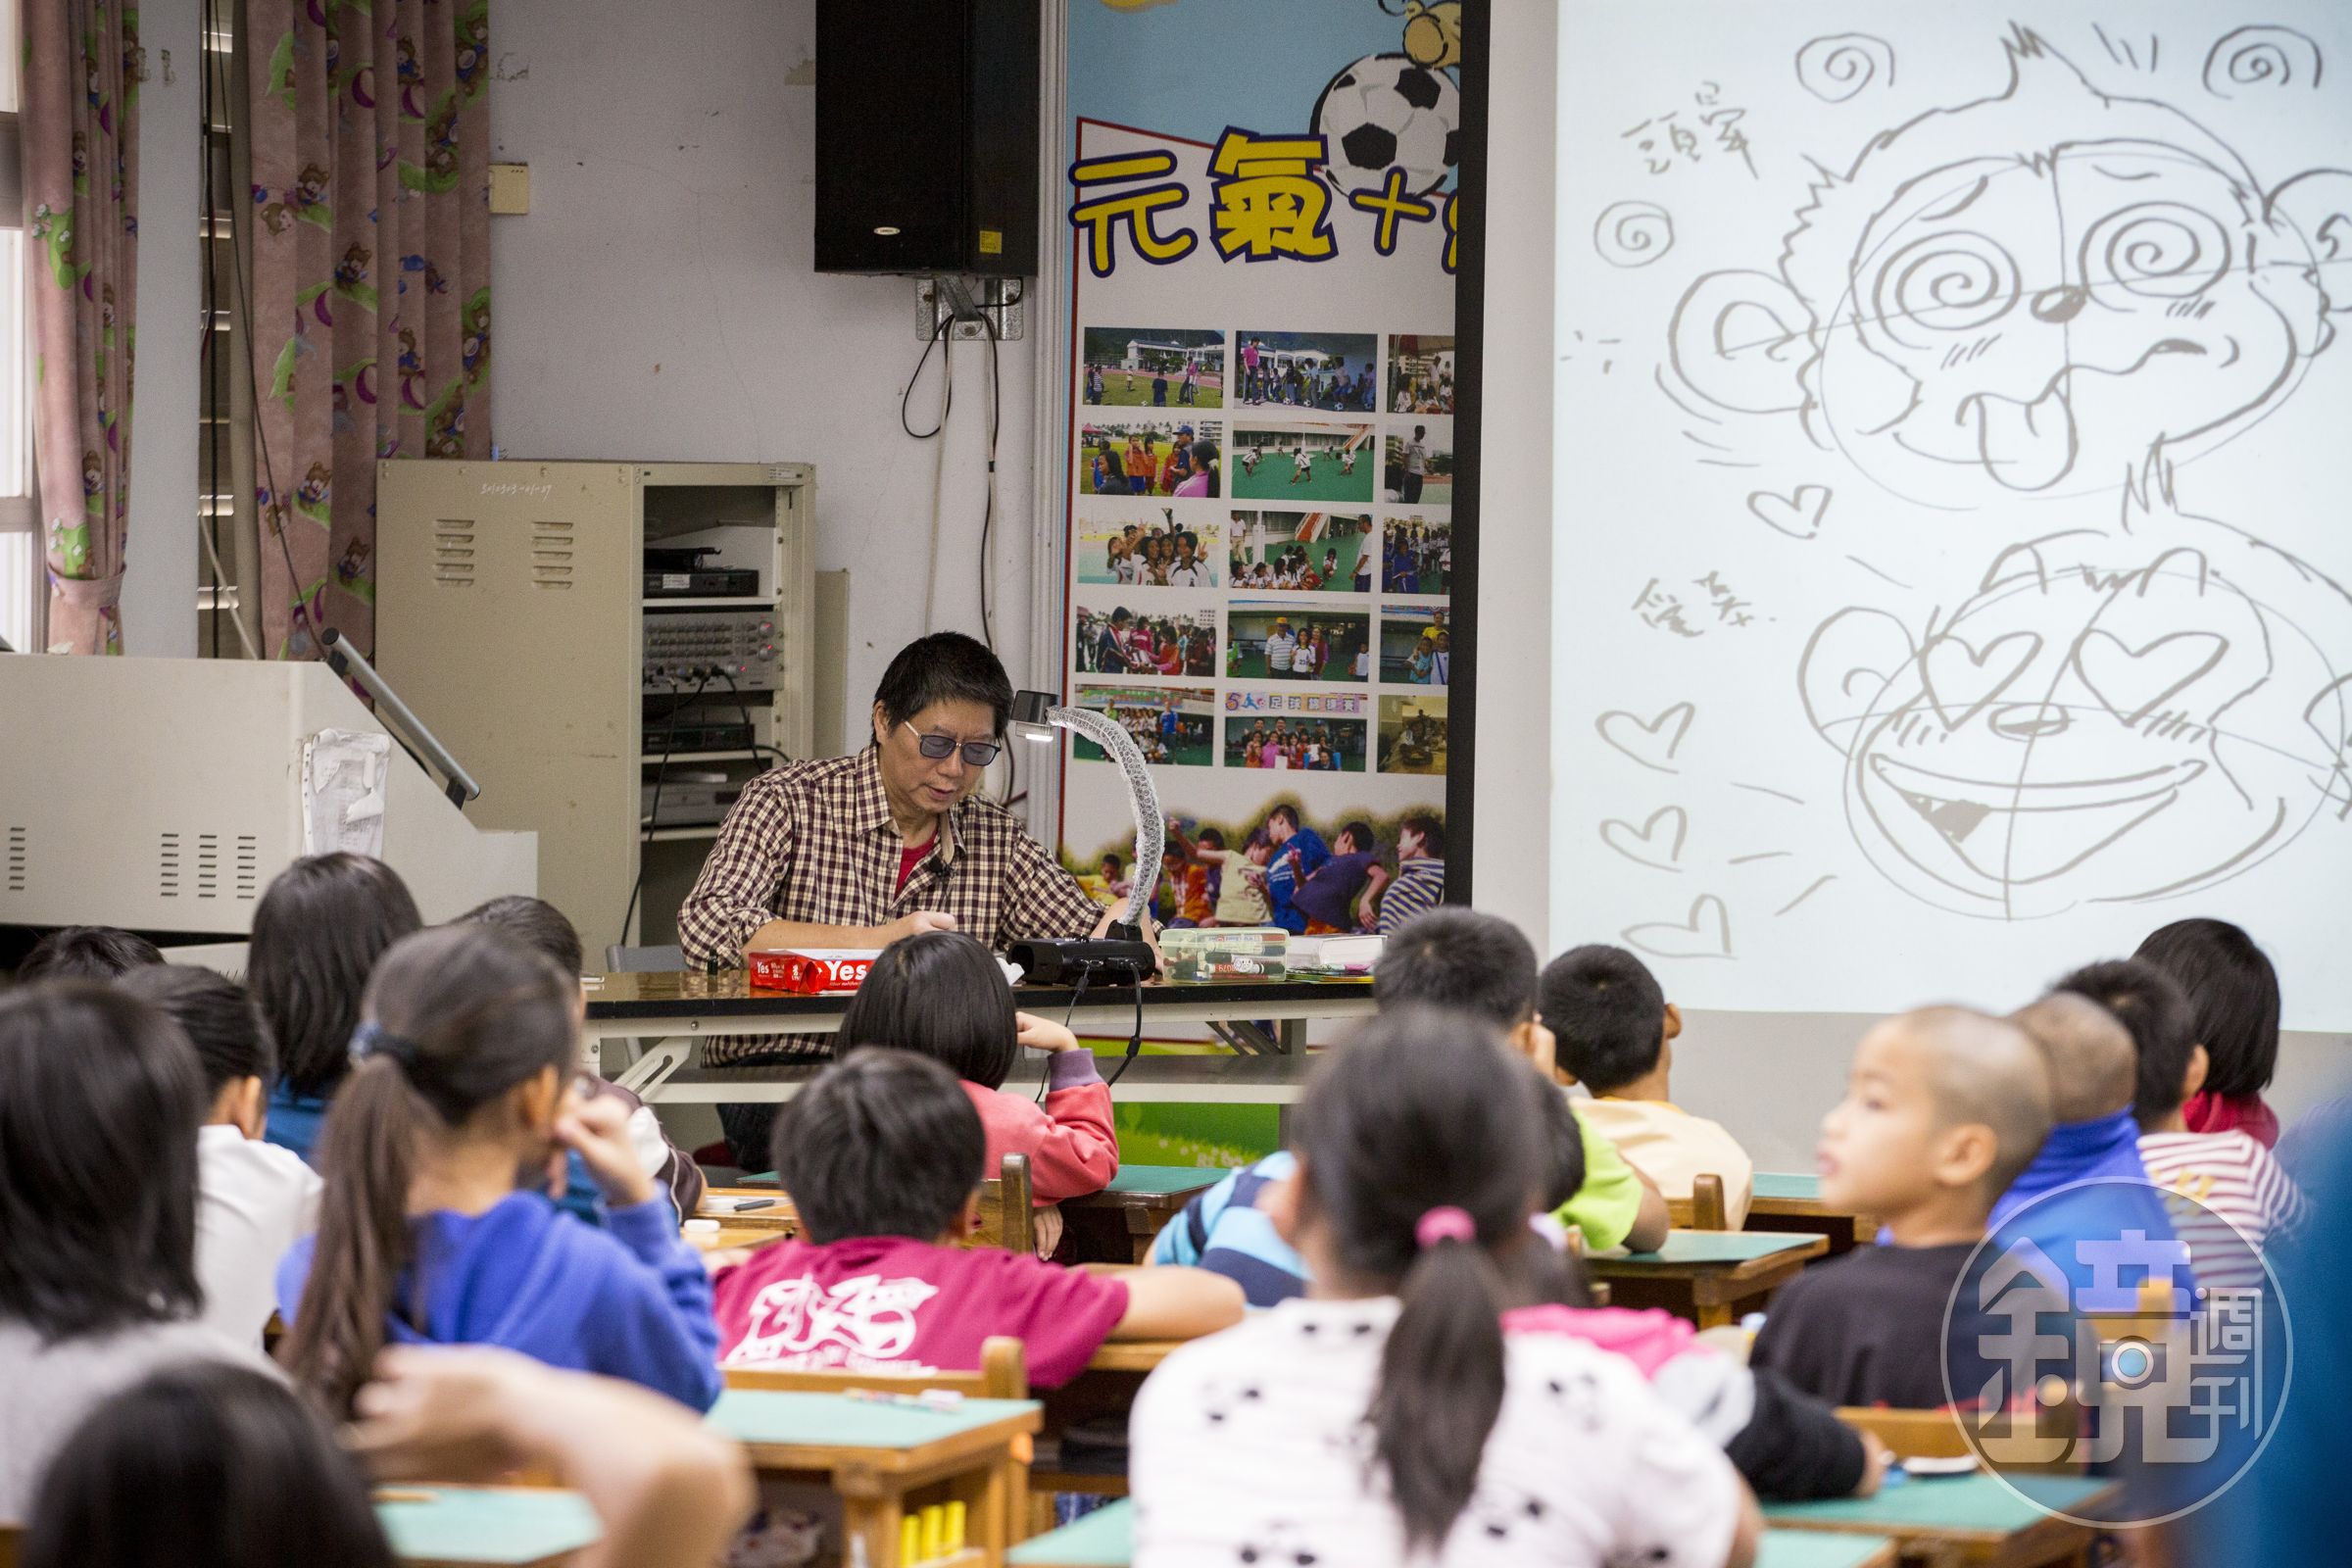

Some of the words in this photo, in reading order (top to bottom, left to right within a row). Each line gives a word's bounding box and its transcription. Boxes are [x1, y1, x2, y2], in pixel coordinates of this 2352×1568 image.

[1068, 124, 1457, 278] 元氣十
[758, 961, 769, 974] Yes
[824, 960, 867, 981] Yes
